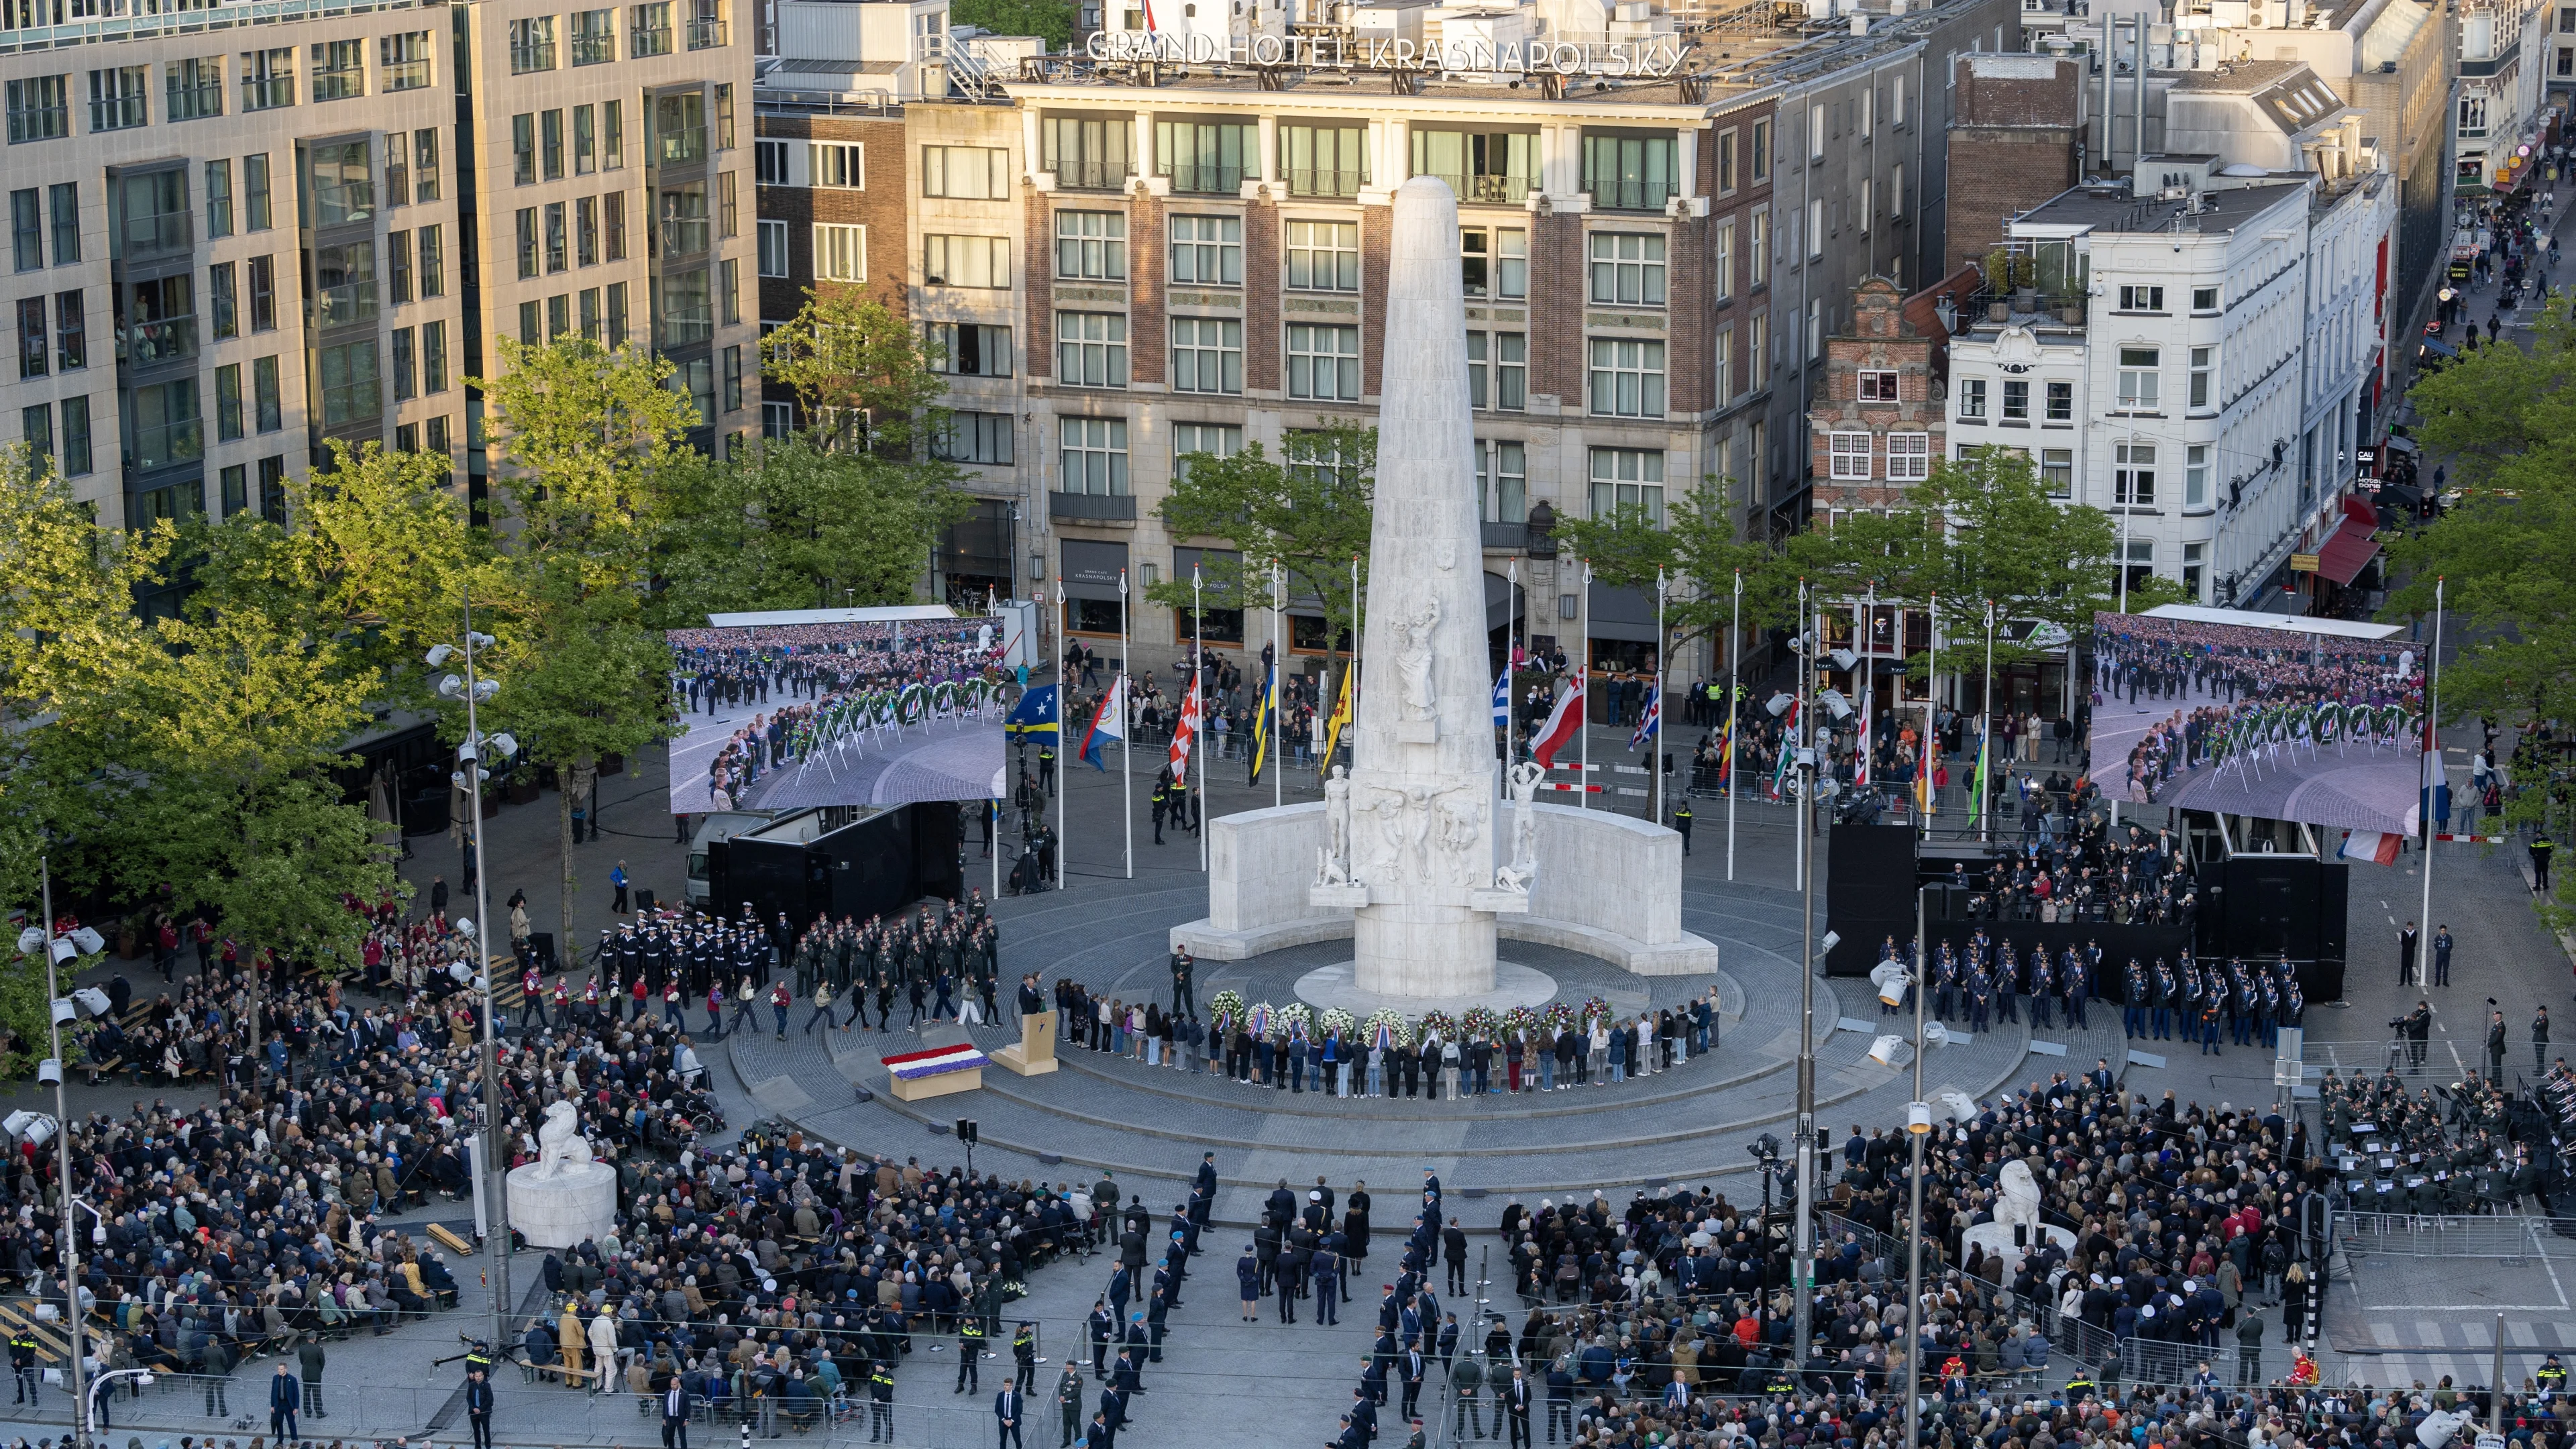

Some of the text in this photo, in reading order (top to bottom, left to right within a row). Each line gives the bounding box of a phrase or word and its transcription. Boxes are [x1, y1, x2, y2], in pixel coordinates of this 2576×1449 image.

[1086, 30, 1690, 77] GRAND HOTEL KRASNAPOLSKY
